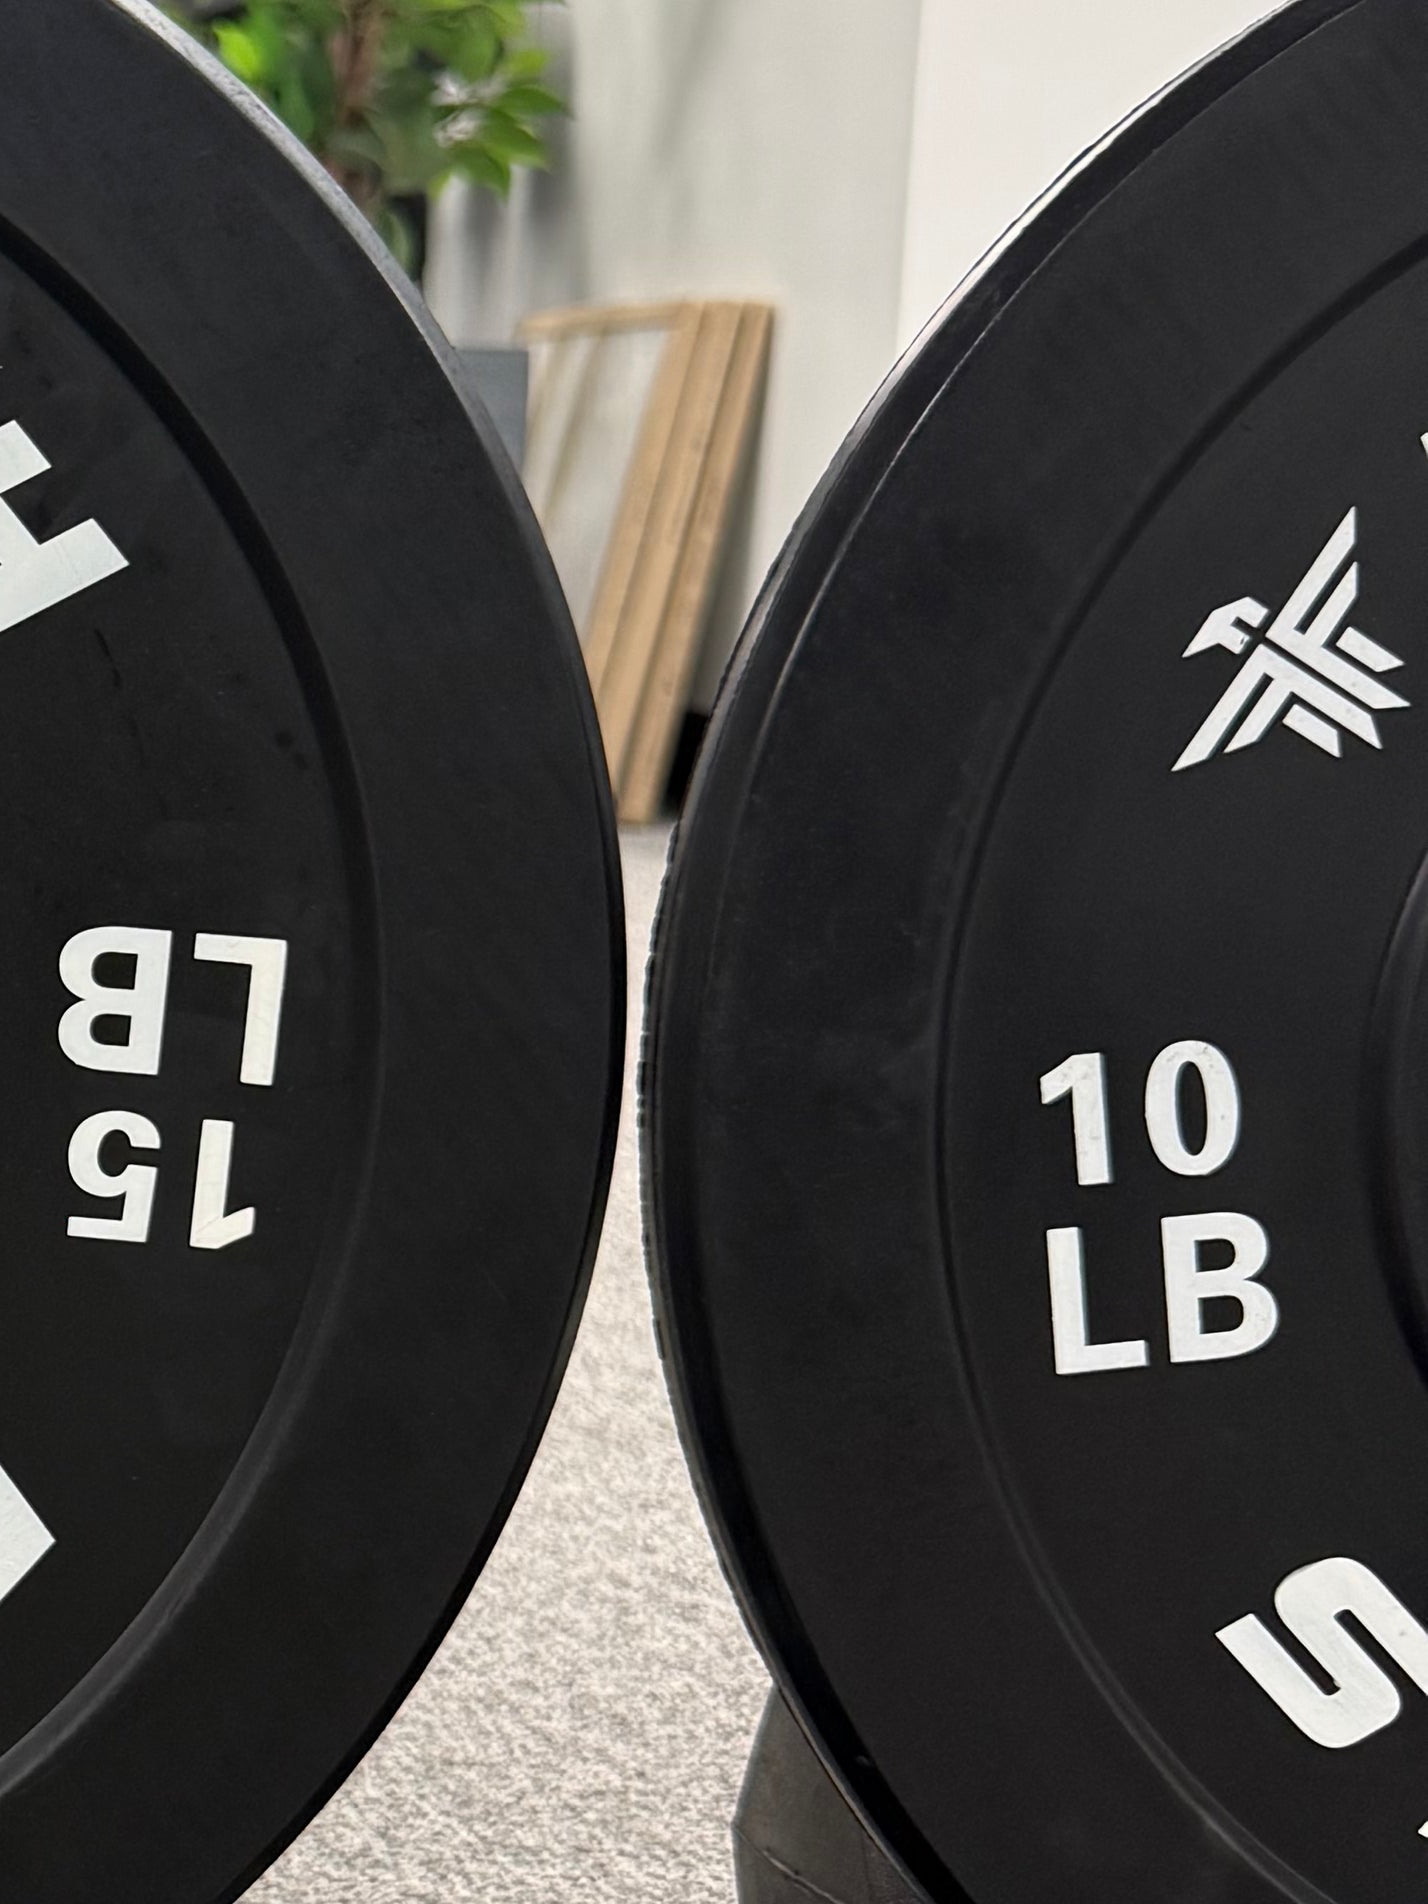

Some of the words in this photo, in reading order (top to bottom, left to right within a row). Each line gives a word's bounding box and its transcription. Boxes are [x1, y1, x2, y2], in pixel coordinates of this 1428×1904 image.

[58, 926, 289, 1086] LB
[66, 1110, 256, 1250] 15
[1039, 1040, 1240, 1187] 10
[1045, 1211, 1279, 1376] LB
